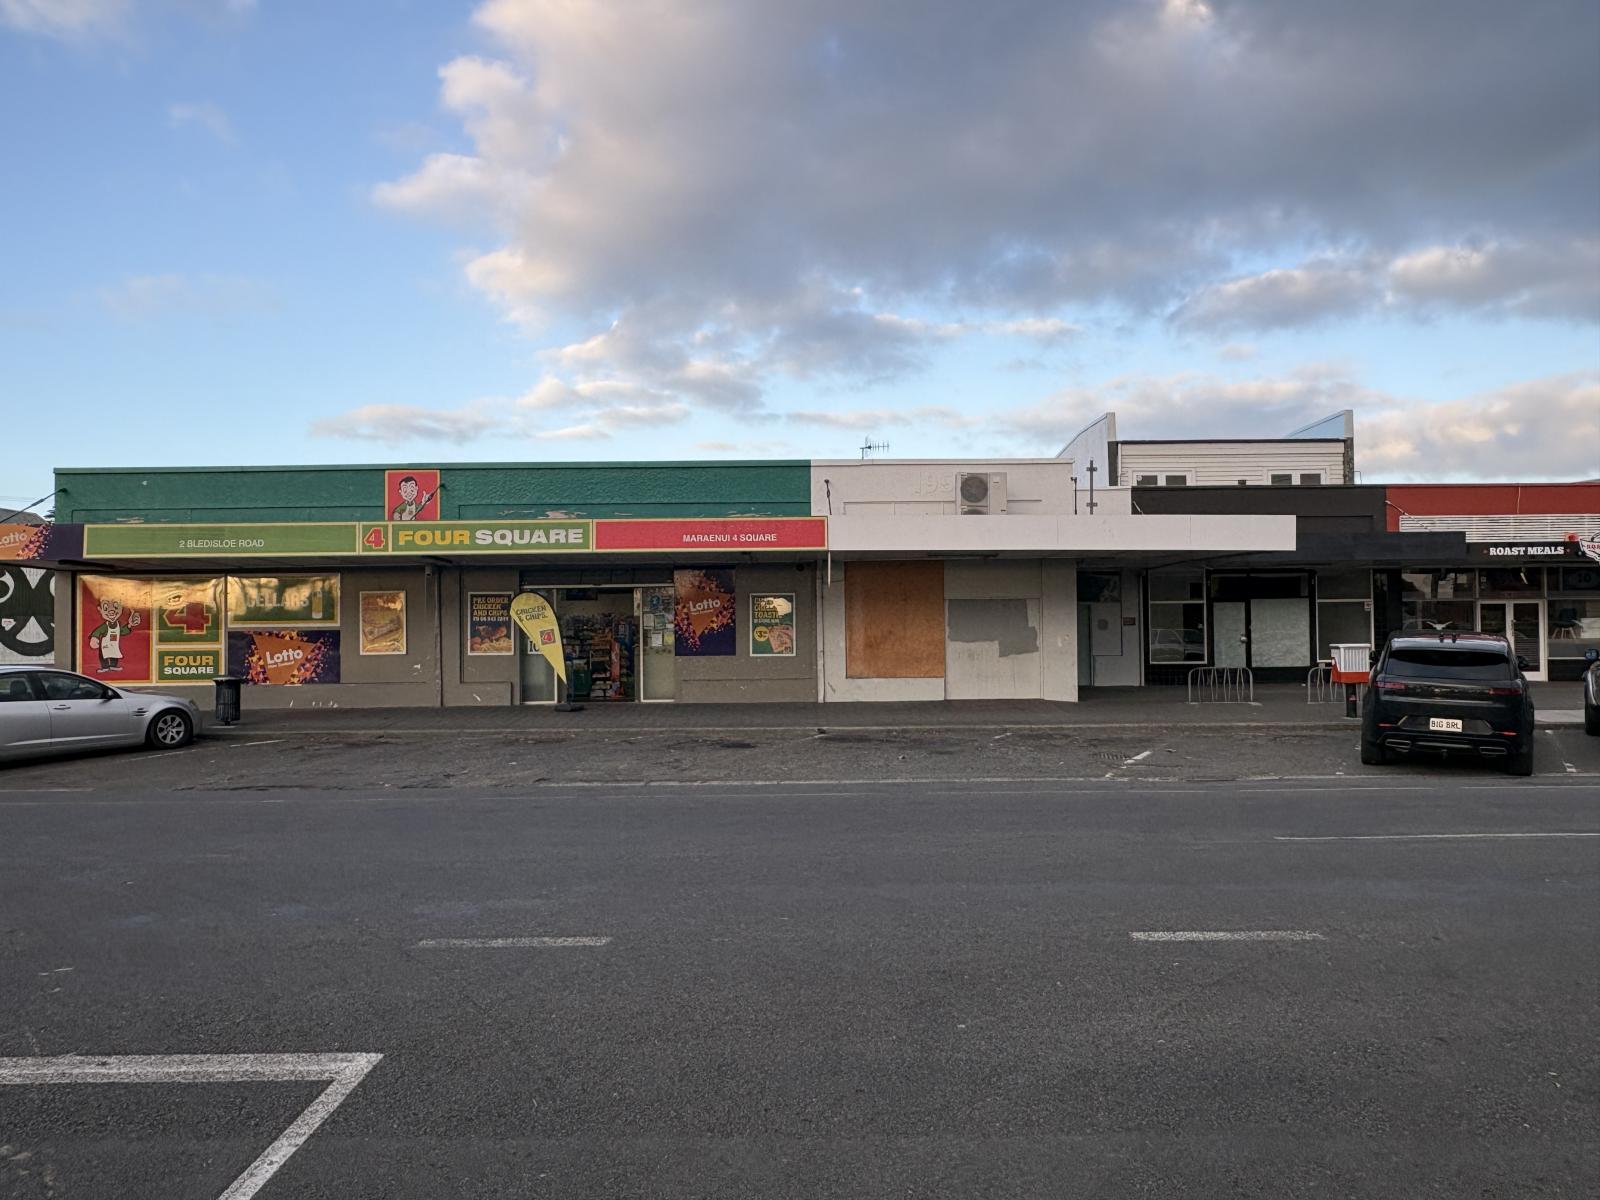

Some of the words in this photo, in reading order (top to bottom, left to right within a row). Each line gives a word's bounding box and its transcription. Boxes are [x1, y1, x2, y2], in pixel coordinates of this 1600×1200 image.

[0, 531, 28, 546] otto
[364, 527, 386, 550] 4
[398, 529, 471, 545] FOUR
[474, 528, 584, 546] SQUARE
[682, 534, 731, 543] MARAENUI
[732, 534, 738, 542] 4
[739, 533, 778, 542] SQUARE
[178, 539, 186, 548] 2
[187, 539, 237, 548] BLEDISLOE
[238, 538, 265, 548] ROAD
[1489, 547, 1526, 556] ROAST
[1527, 546, 1565, 555] MEALS
[515, 605, 547, 616] CHICKEN
[689, 598, 721, 612] Lotto
[163, 655, 214, 666] FOUR
[265, 648, 304, 665] Lotto
[163, 666, 214, 675] SQUARE
[1431, 720, 1444, 729] BIG
